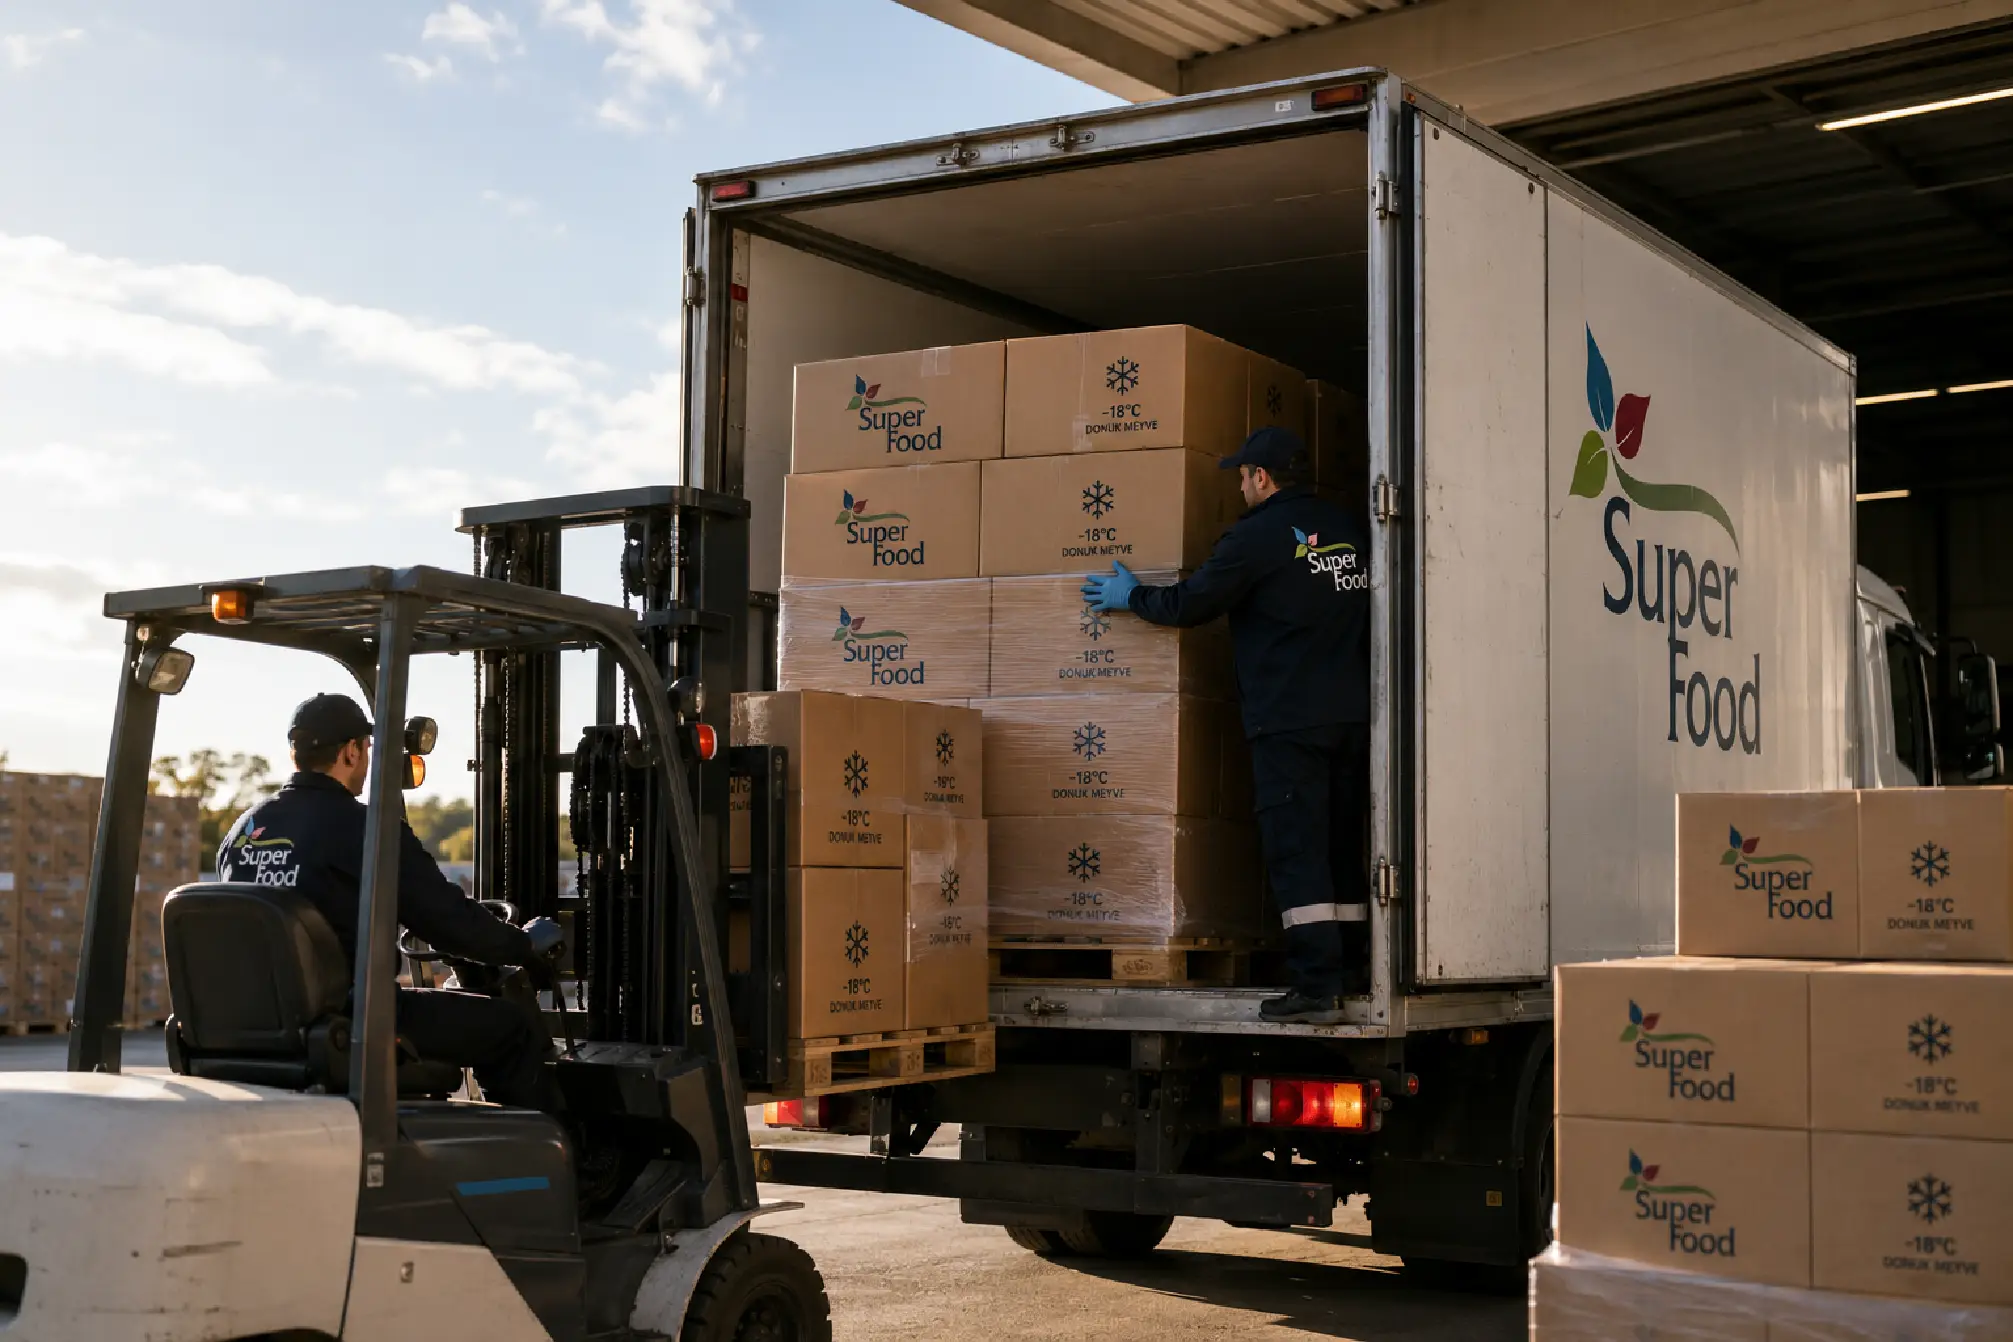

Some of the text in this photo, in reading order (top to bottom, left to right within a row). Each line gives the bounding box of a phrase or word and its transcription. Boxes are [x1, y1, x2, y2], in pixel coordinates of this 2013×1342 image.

[858, 407, 925, 432] Super
[1102, 404, 1141, 418] -18°C
[886, 426, 942, 453] Food
[846, 521, 908, 546] Super
[1078, 528, 1116, 542] -18°C
[873, 541, 924, 566] Food
[1307, 551, 1356, 574] Super
[1334, 568, 1368, 591] Food
[1603, 496, 1739, 642] Super
[843, 639, 907, 664] Super
[870, 660, 924, 686] Food
[1667, 636, 1762, 755] Food
[1068, 770, 1108, 785] -18°C
[238, 844, 292, 866] Super
[255, 864, 299, 887] Food
[1733, 863, 1812, 893] Super
[1767, 891, 1833, 921] Food
[1634, 1040, 1714, 1072] Super
[1669, 1070, 1735, 1102] Food
[1634, 1190, 1715, 1226] Super
[1669, 1221, 1736, 1257] Food
